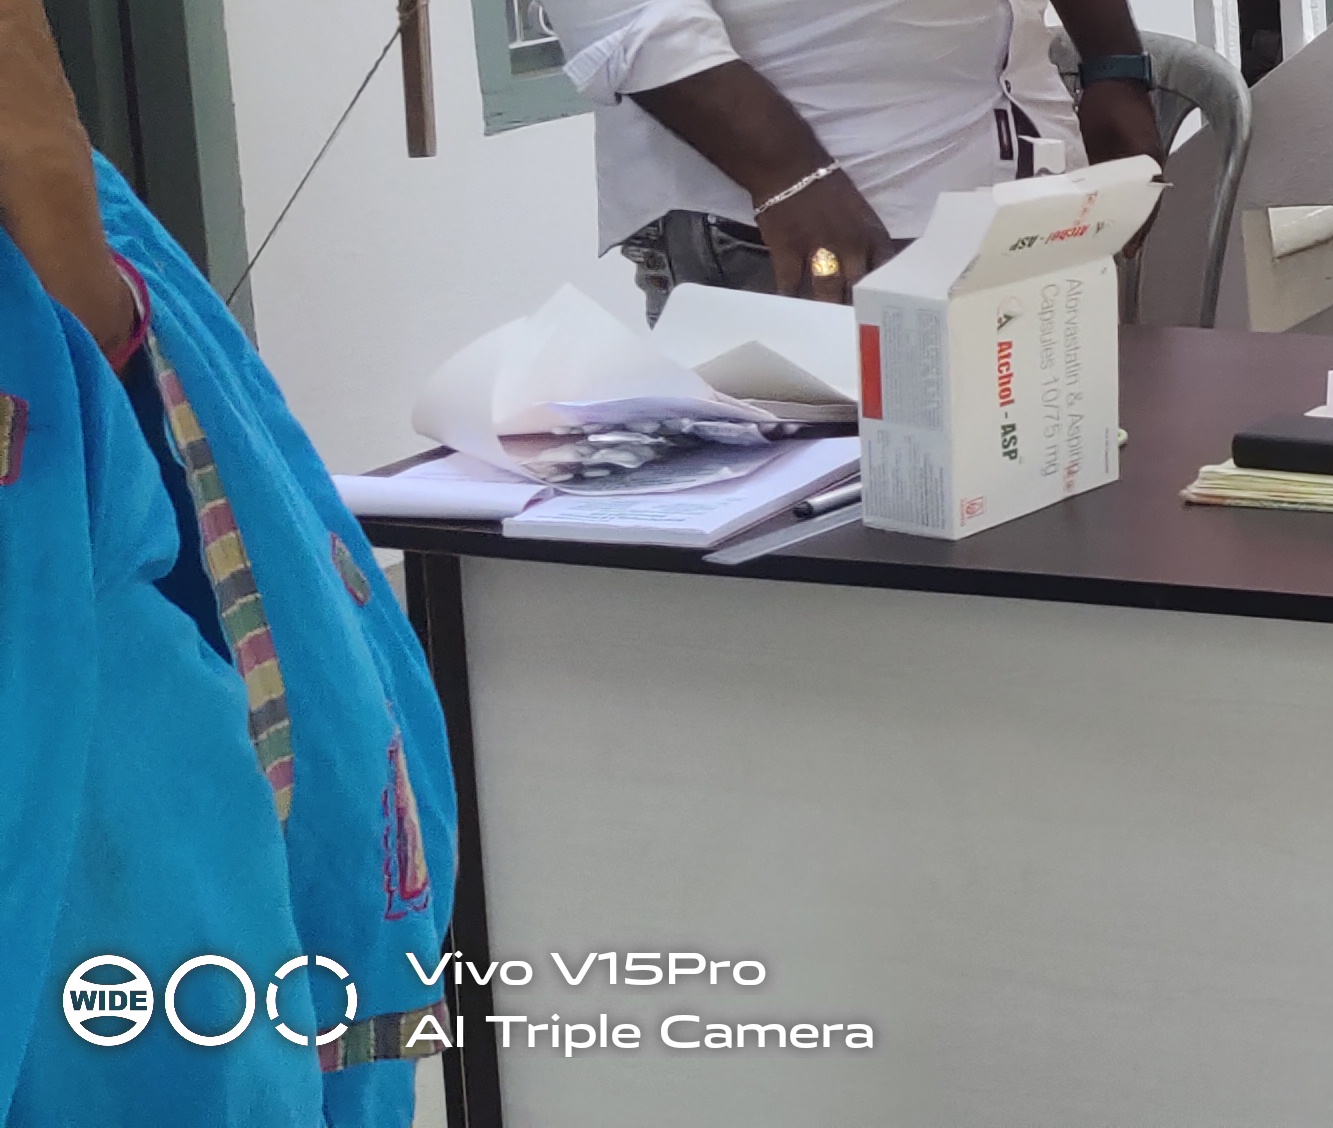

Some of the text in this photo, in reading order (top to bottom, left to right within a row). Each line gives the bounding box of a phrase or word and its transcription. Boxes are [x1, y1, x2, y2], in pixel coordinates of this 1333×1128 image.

[1039, 283, 1060, 370] Capsules
[997, 341, 1015, 407] Atchol
[1041, 375, 1062, 439] 10/75
[1001, 423, 1019, 461] ASP
